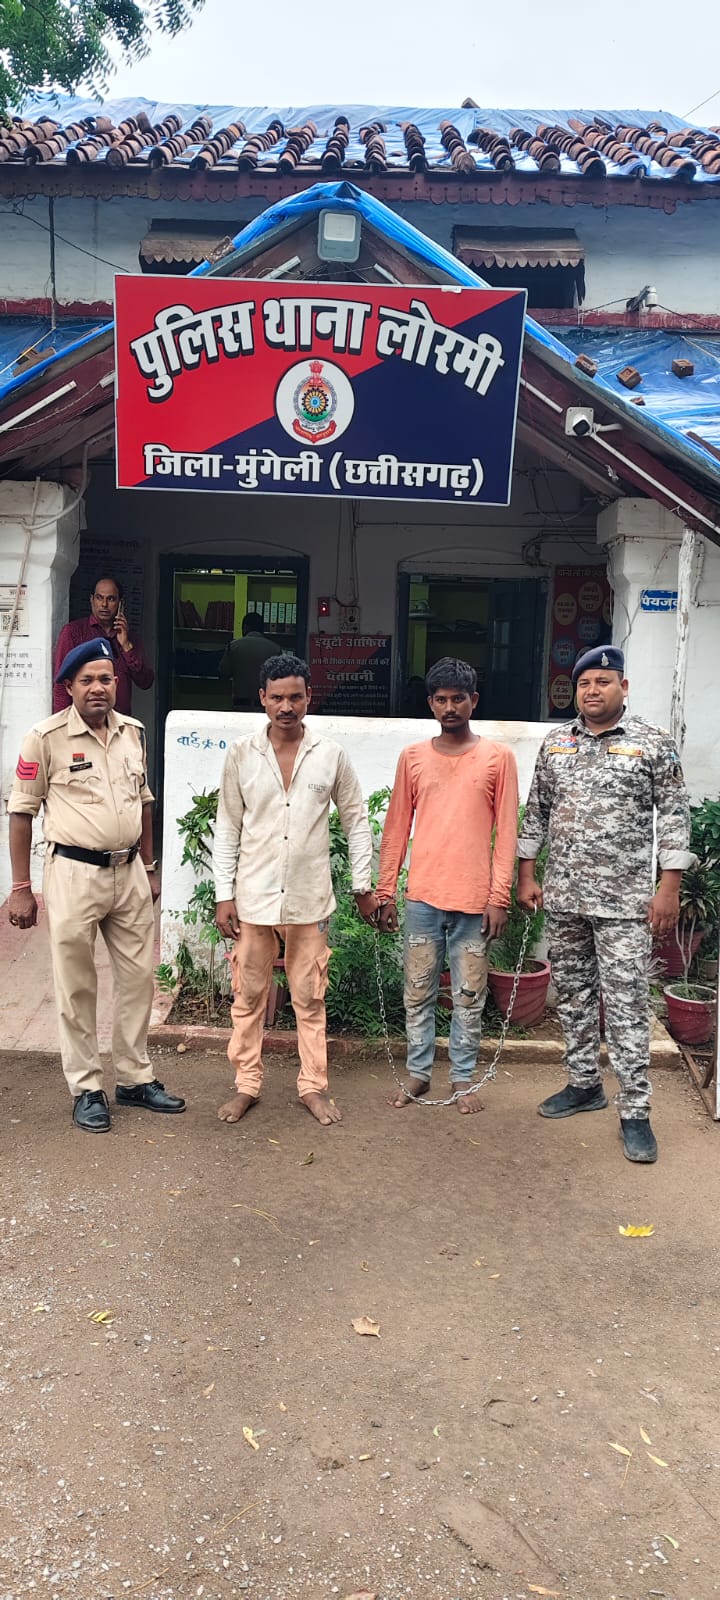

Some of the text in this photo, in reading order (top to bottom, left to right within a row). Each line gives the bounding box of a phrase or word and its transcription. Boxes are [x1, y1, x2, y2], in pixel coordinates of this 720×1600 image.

[130, 298, 505, 402] पुलिस थाना लोरमी
